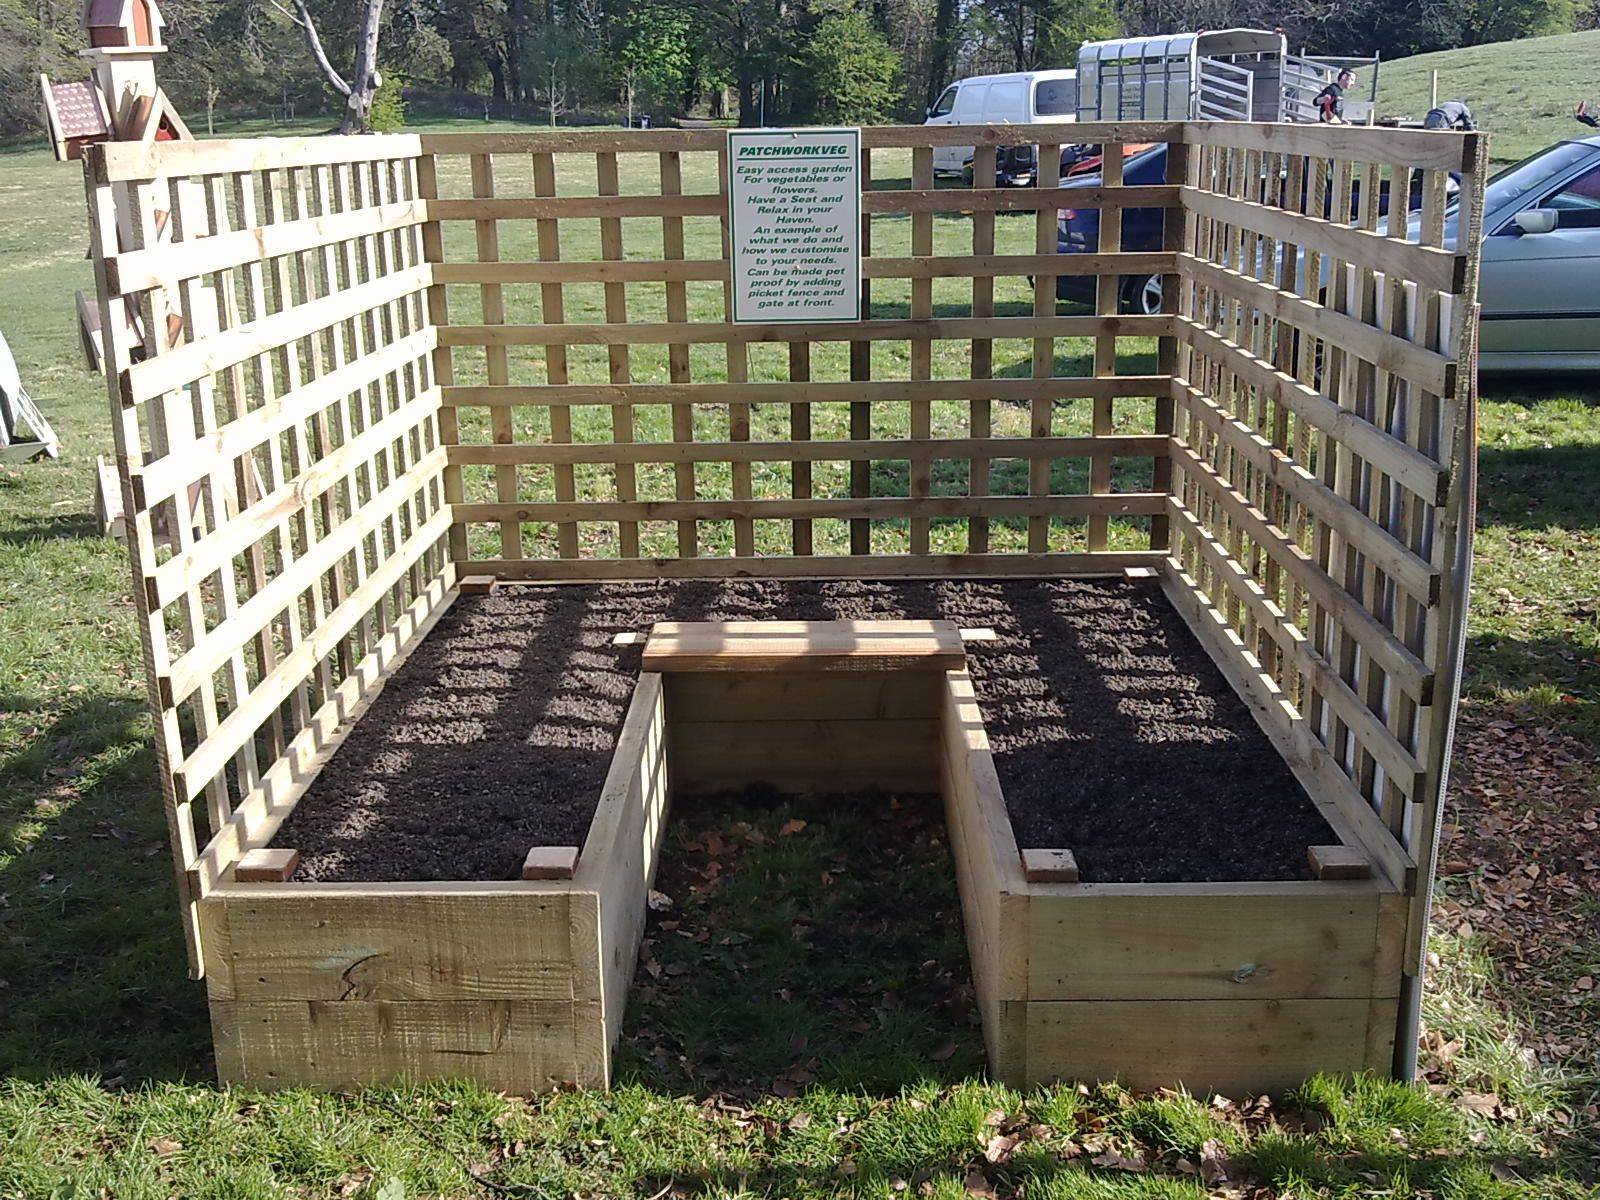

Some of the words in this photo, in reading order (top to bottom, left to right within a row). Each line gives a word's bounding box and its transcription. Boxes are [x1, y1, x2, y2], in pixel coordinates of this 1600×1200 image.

[737, 166, 764, 175] Easy
[812, 164, 853, 175] garden
[743, 175, 762, 183] For
[767, 175, 829, 185] vegetables
[772, 186, 818, 194] flowers.
[747, 196, 779, 204] Have
[790, 195, 818, 203] Seat
[821, 195, 844, 203] and
[757, 206, 789, 214] Relax
[807, 206, 833, 214] your
[775, 216, 814, 224] Haven.
[753, 226, 771, 234] An
[774, 225, 822, 235] example
[825, 225, 838, 233] of
[821, 235, 844, 243] and
[742, 247, 767, 255] how
[791, 246, 850, 254] customise
[771, 258, 797, 266] your
[800, 256, 837, 264] needs.
[747, 268, 769, 276] Can
[773, 268, 788, 276] be
[825, 268, 846, 276] pet
[750, 279, 785, 288] proof
[786, 279, 800, 288] by
[803, 278, 842, 287] adding
[748, 289, 784, 298] picket
[787, 288, 820, 296] fence
[823, 288, 845, 296] and
[757, 299, 784, 309] gate
